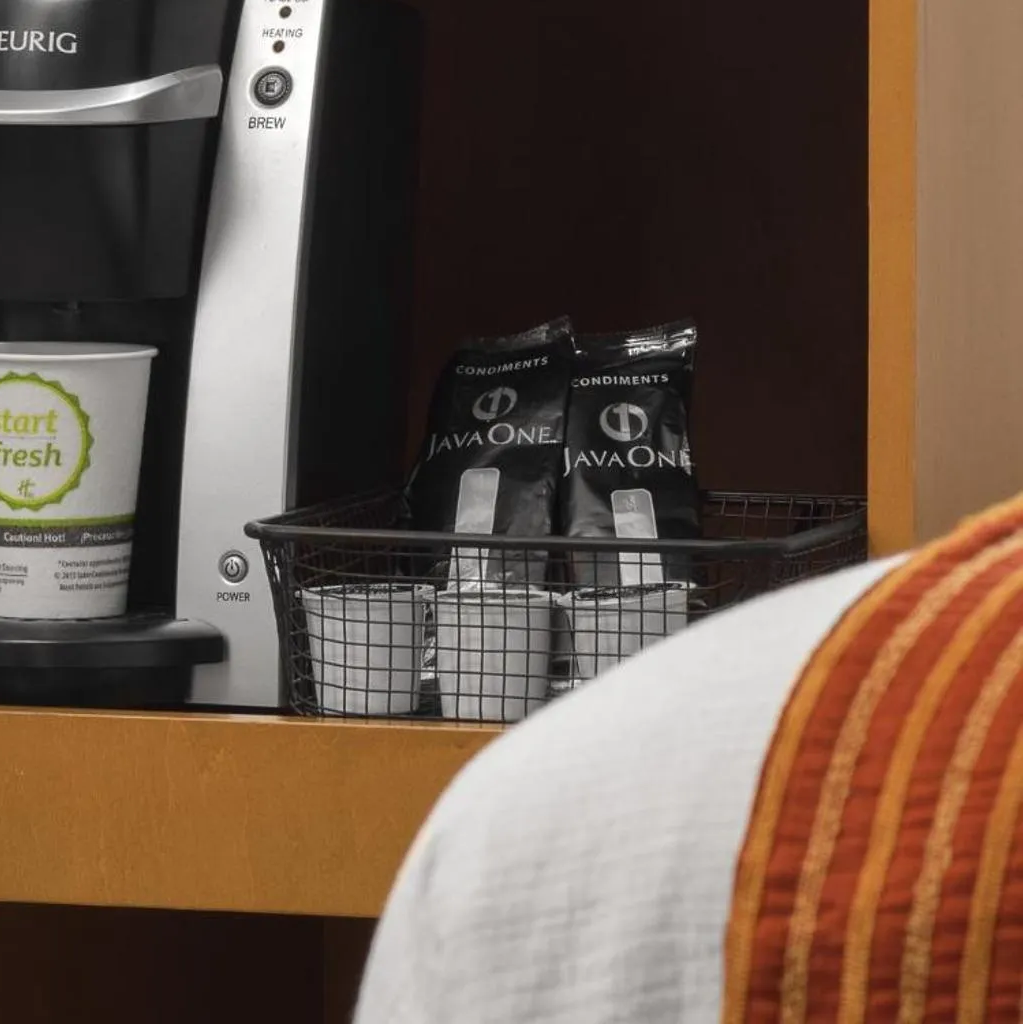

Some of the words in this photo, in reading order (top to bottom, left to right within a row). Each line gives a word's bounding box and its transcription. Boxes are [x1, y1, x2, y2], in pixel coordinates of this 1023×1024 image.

[262, 28, 303, 38] HEATING
[248, 116, 286, 129] BREW
[455, 356, 549, 376] CONDIMENTS
[44, 532, 66, 543] Hot!
[217, 592, 250, 602] POWER
